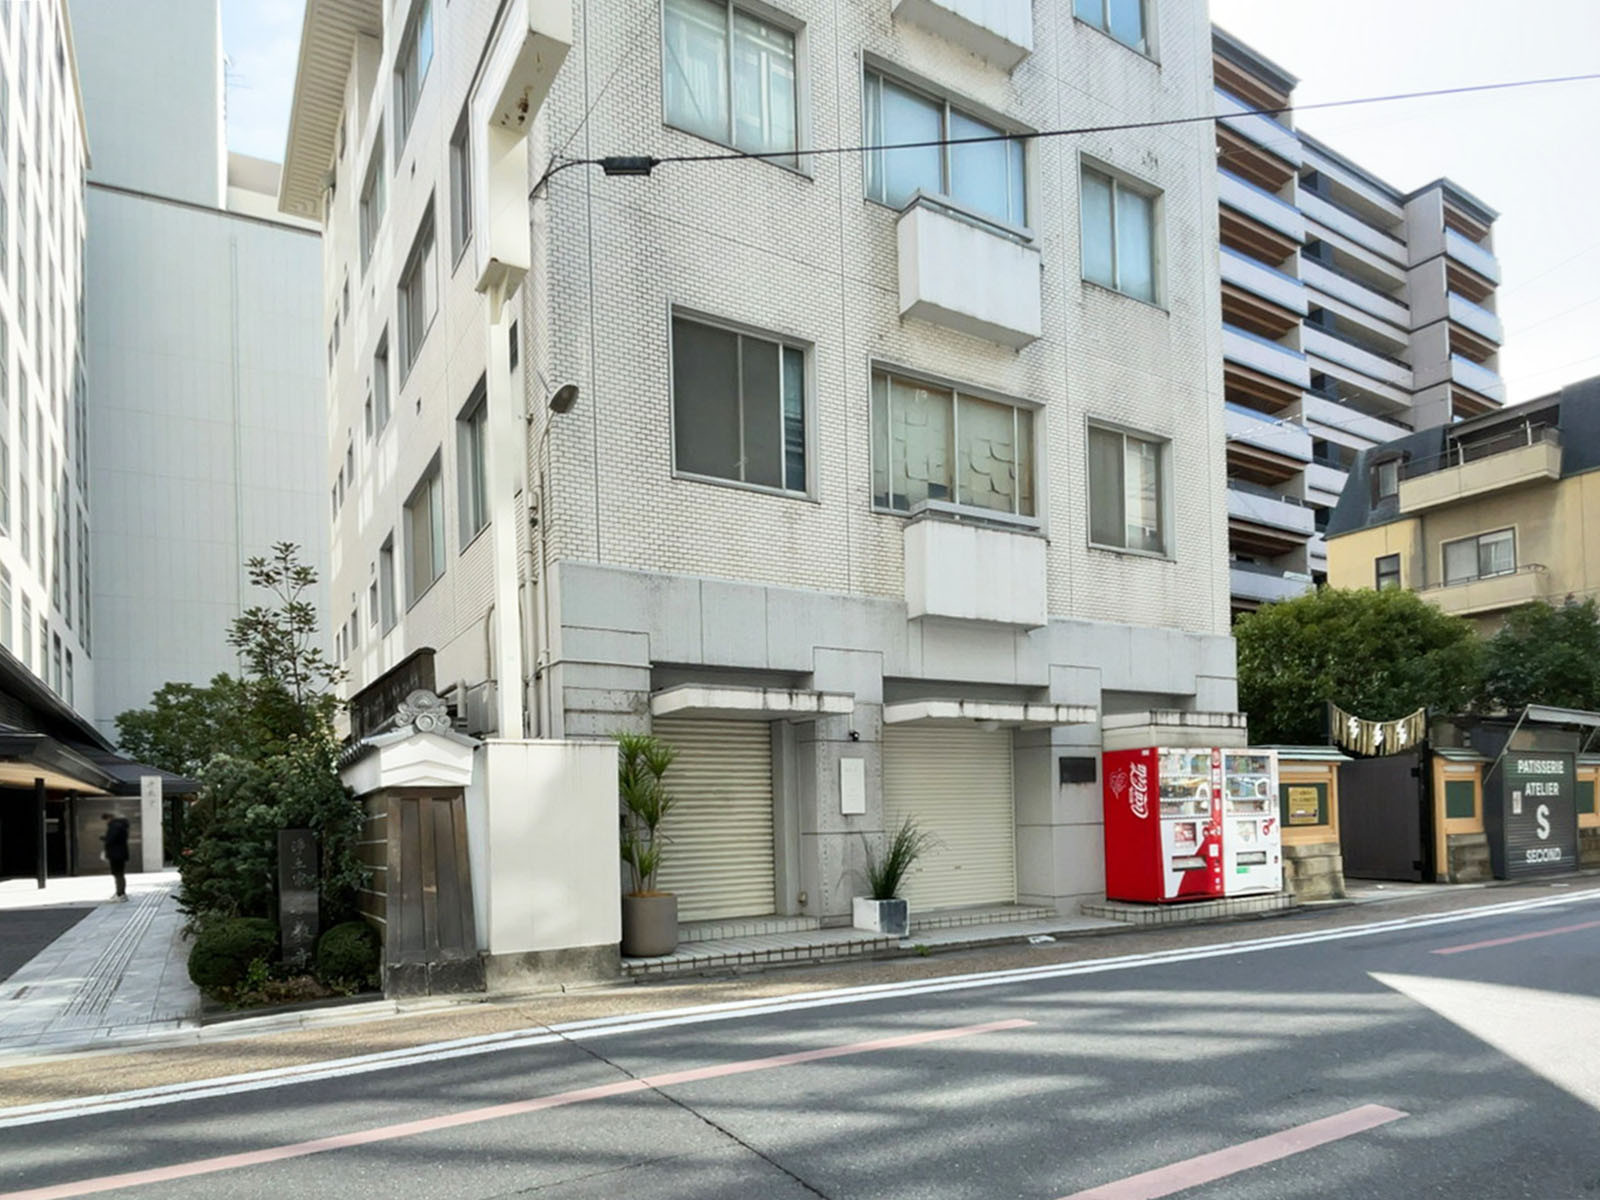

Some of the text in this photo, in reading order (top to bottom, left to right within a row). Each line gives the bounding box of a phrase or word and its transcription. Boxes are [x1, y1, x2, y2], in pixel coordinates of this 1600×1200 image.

[1517, 759, 1564, 774] PATISSERIE
[1129, 761, 1149, 819] Coca-Cola
[1525, 782, 1560, 796] ATELIER
[1536, 804, 1550, 840] S
[1526, 847, 1562, 863] SECOND
